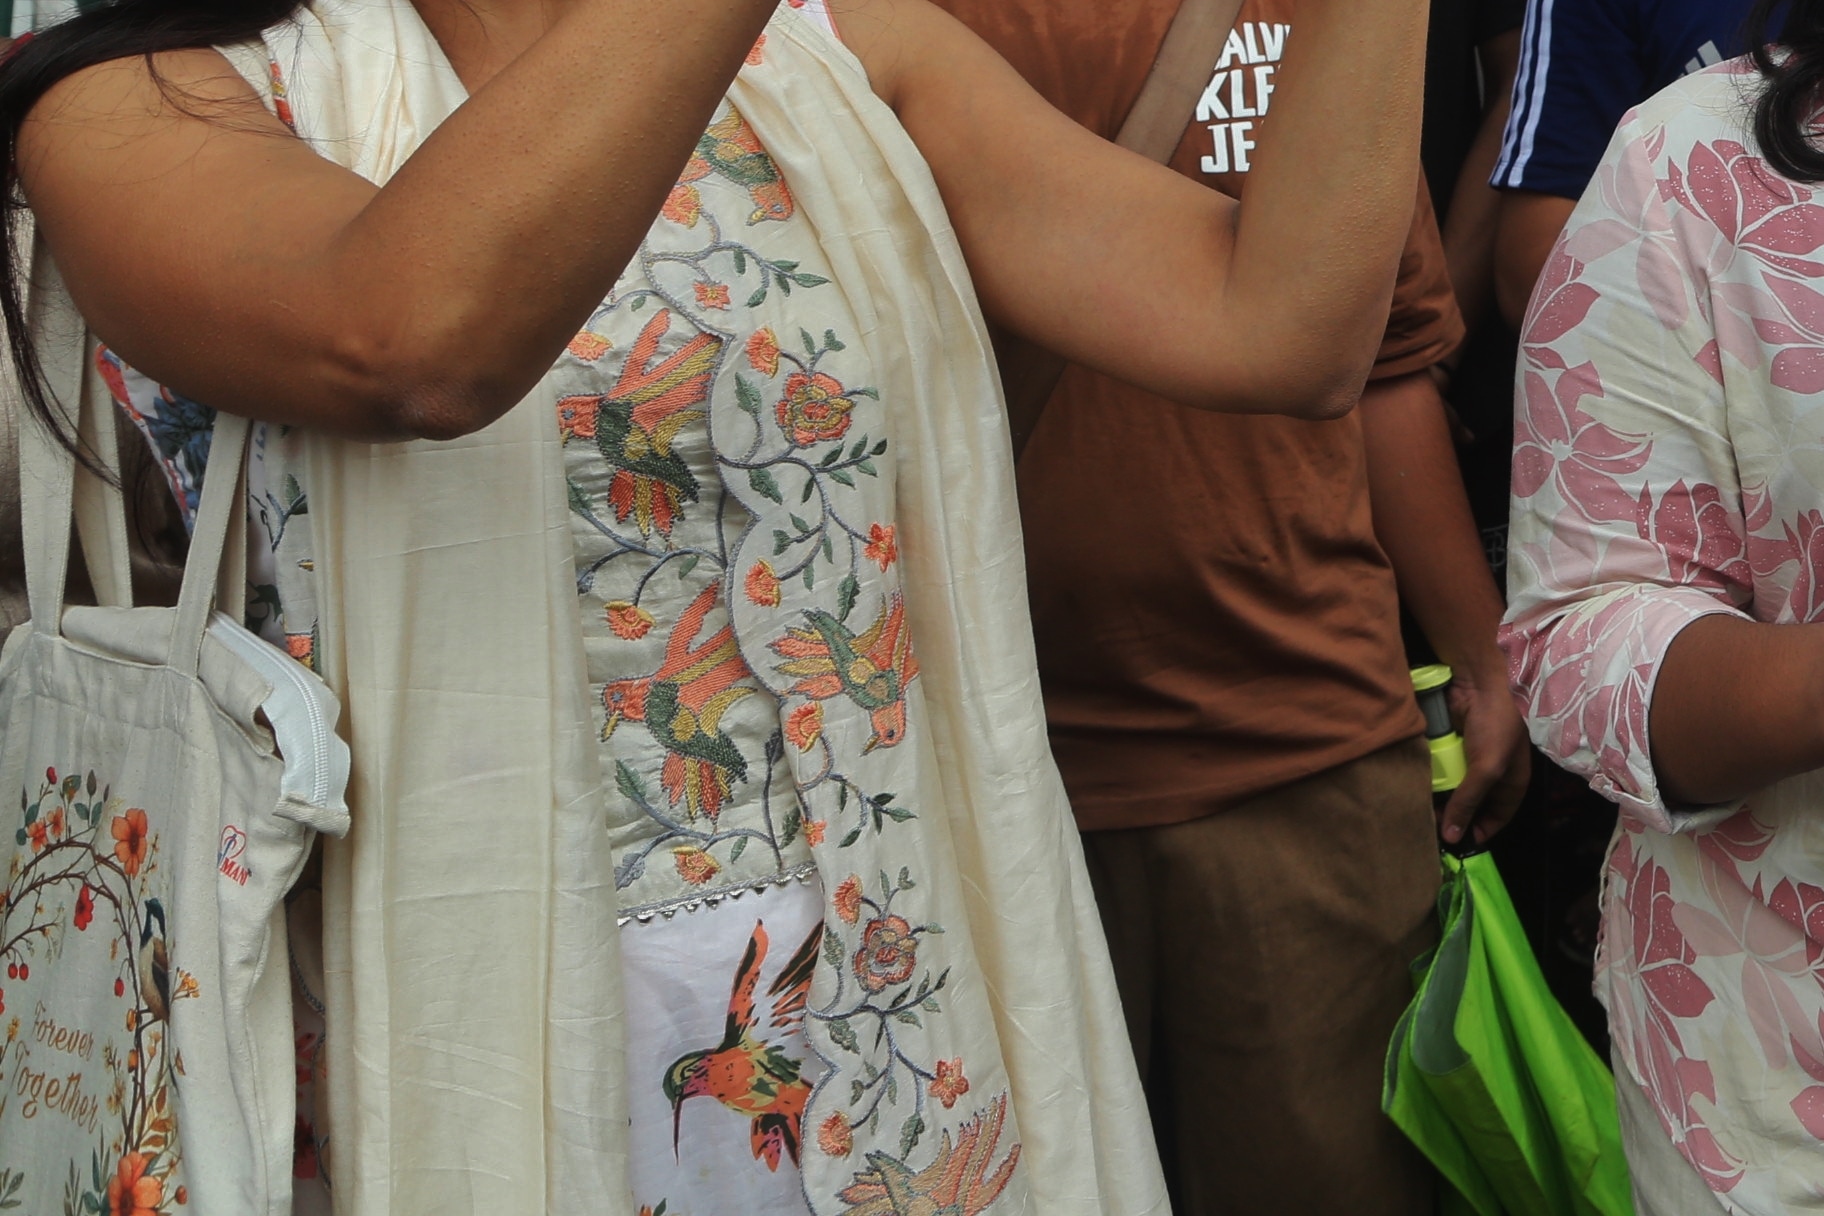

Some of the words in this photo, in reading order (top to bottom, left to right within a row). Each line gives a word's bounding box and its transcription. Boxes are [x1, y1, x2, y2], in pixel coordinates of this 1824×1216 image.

[1214, 21, 1291, 70] ALV
[1196, 64, 1279, 121] KLE
[1201, 121, 1258, 173] JE
[32, 1000, 94, 1062] Forever
[10, 1040, 98, 1134] Together
